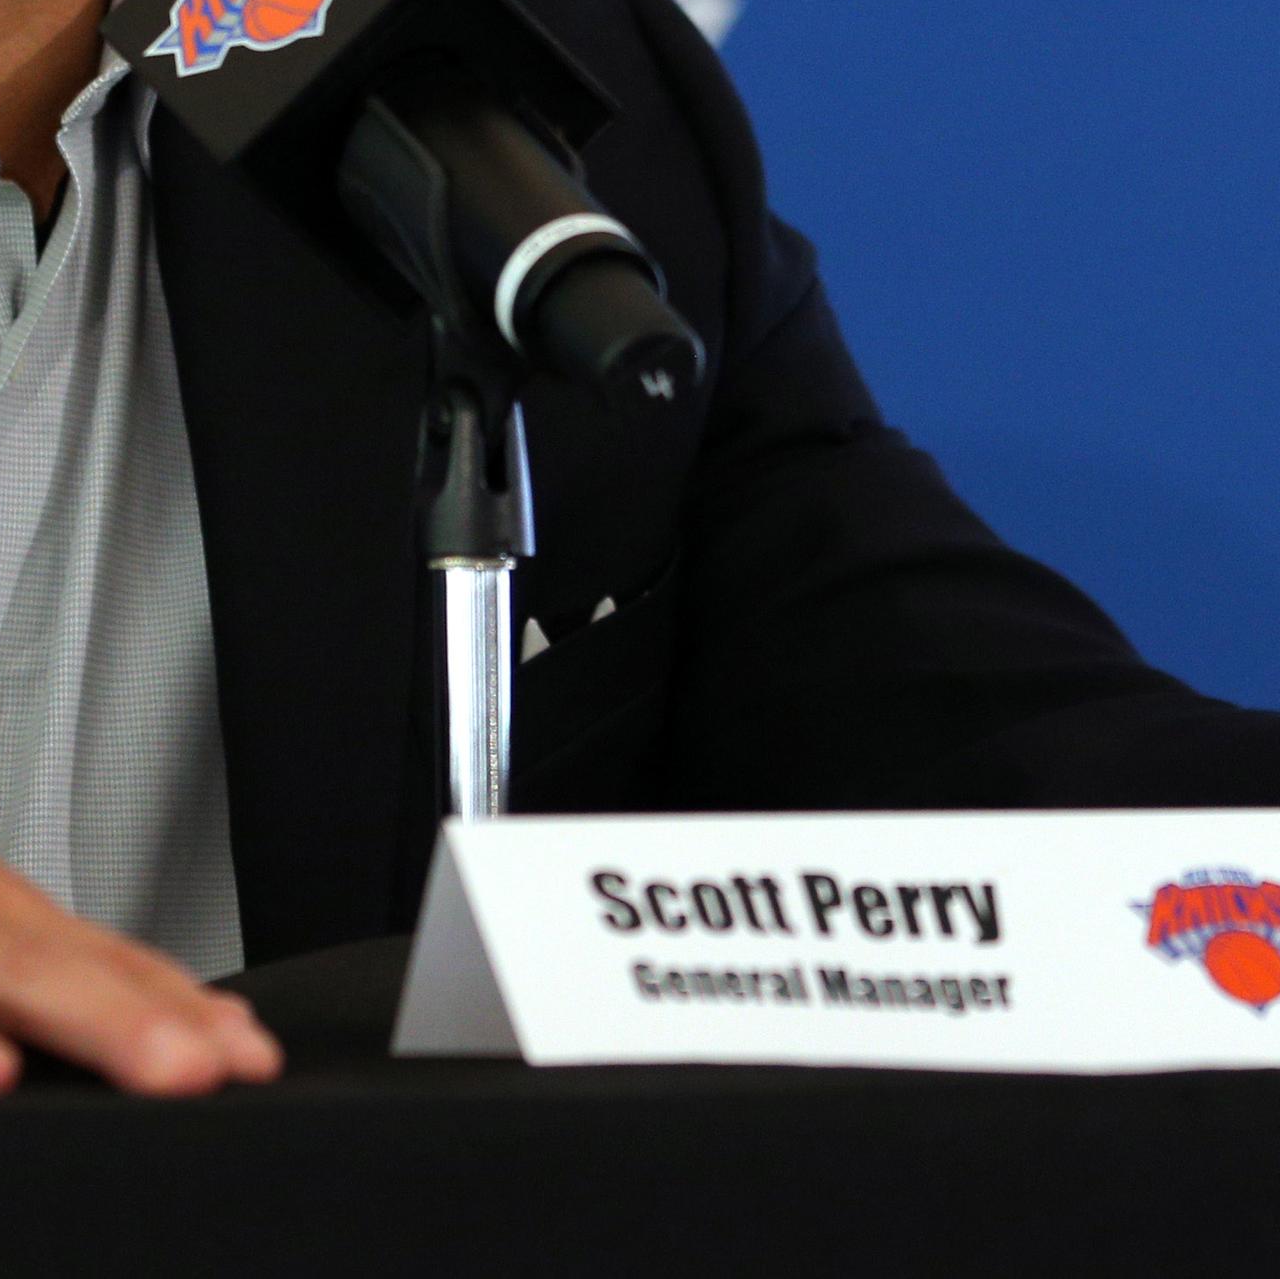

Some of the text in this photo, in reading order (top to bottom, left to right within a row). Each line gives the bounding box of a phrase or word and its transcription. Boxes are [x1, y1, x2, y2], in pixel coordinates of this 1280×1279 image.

[590, 870, 1001, 944] Scott Perry
[631, 961, 1010, 1013] General Manager
